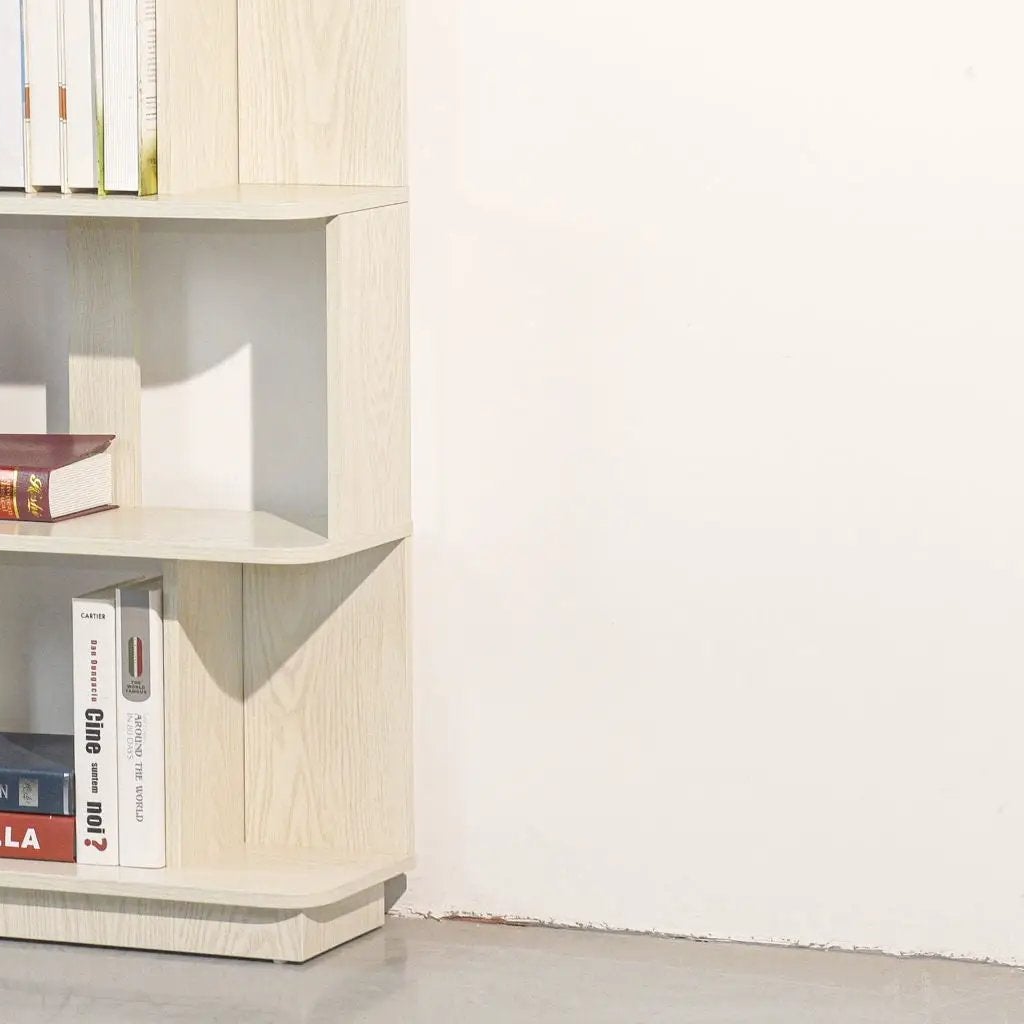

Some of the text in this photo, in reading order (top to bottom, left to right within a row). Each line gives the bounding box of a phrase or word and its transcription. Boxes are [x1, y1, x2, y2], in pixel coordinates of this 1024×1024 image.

[80, 612, 106, 620] CARTIER
[85, 708, 104, 754] Cine
[134, 713, 144, 823] AROUND THE WORLD
